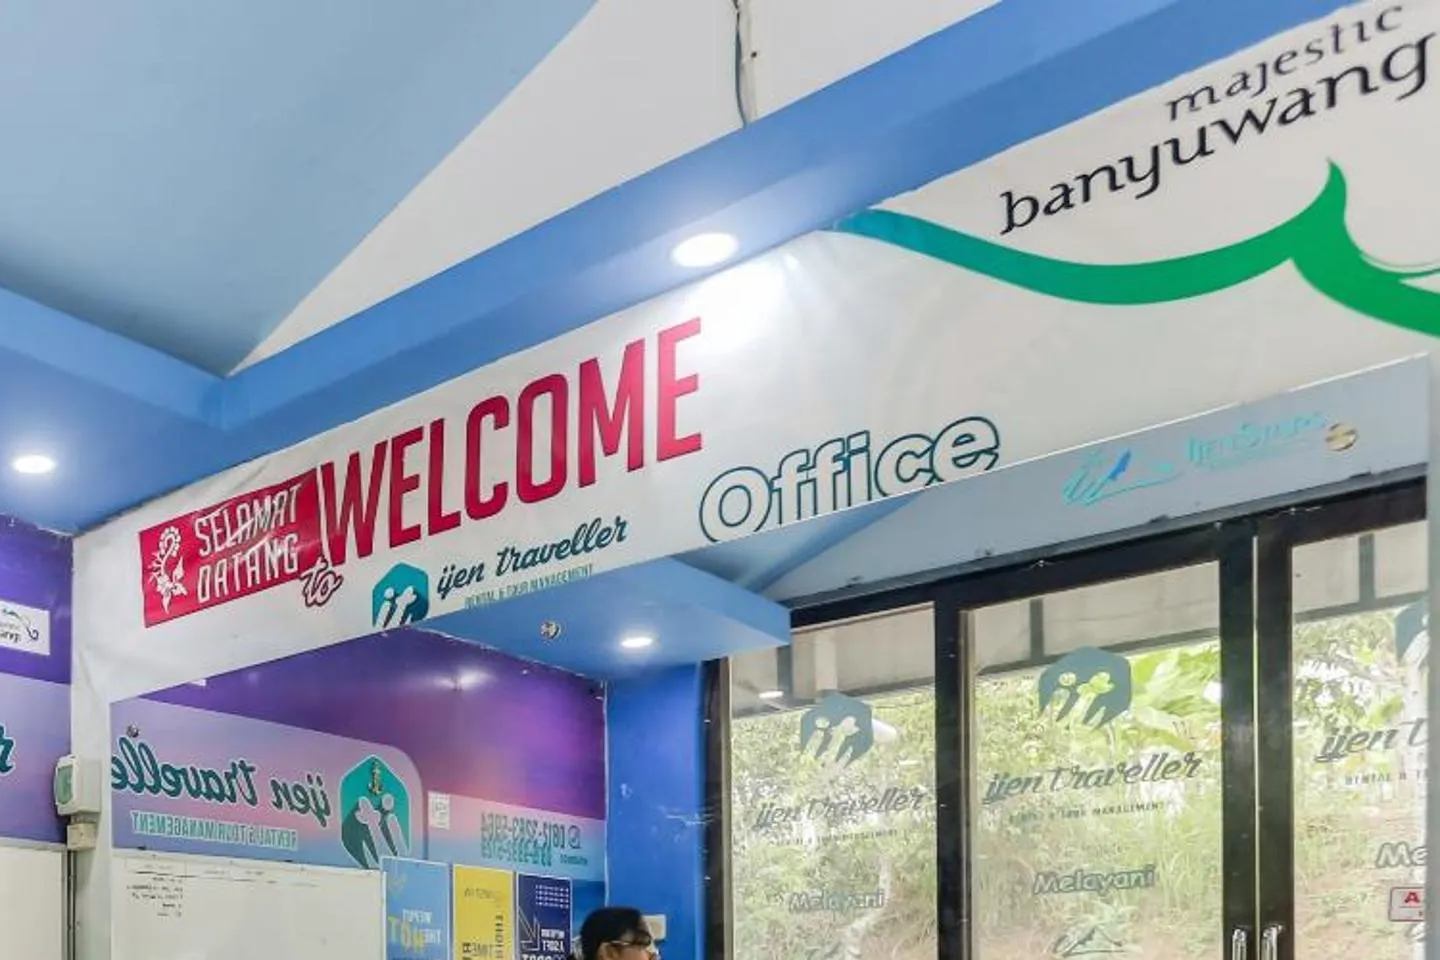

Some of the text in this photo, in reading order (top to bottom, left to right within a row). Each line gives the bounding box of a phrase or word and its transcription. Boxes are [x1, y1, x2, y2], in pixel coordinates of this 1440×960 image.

[1166, 6, 1403, 122] majestic
[999, 31, 1437, 235] banyuwang
[320, 316, 702, 567] WELCOME
[698, 415, 1000, 543] Office
[194, 483, 303, 557] SELAMAT
[436, 514, 628, 600] ijen traveller
[197, 532, 299, 604] DATANG
[299, 555, 345, 608] to
[788, 887, 887, 914] Melayani
[1033, 864, 1157, 896] Melayani
